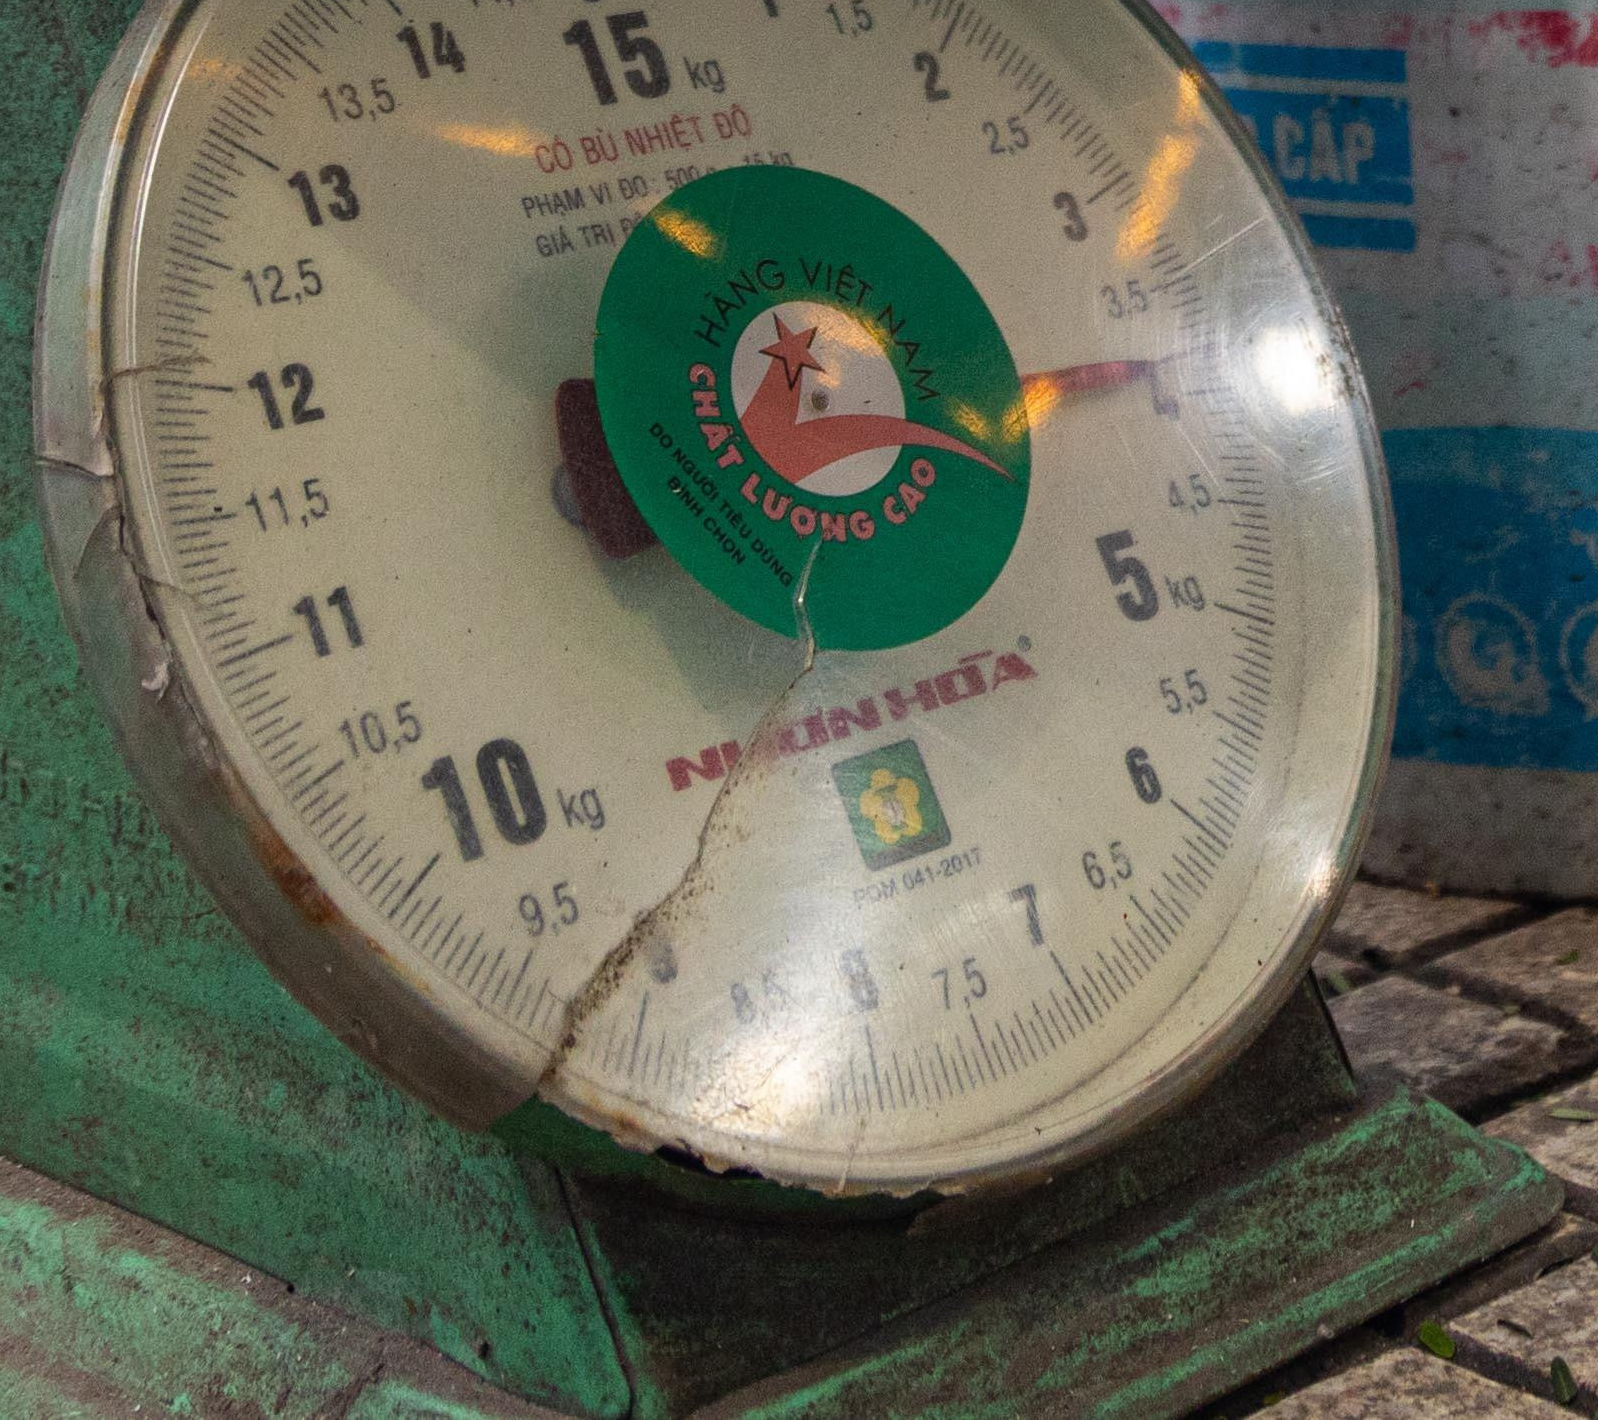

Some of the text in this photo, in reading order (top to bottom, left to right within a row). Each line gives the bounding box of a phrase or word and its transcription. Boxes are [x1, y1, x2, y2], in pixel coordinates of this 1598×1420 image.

[826, 0, 873, 38] 1,5
[396, 21, 466, 80] 14
[562, 10, 726, 105] 15 kg
[913, 51, 951, 102] 2
[318, 77, 396, 123] 13,5
[981, 116, 1031, 156] 2,5
[288, 163, 360, 227] 13
[1052, 191, 1089, 242] 3
[241, 258, 323, 307] 12,5
[1101, 279, 1149, 320] 3,5
[694, 257, 940, 401] HÀNG VIỆT NAM
[247, 362, 326, 430] 12
[649, 422, 673, 449] DO
[245, 477, 329, 532] 11,5
[882, 458, 936, 525] CAO
[1169, 473, 1212, 515] 4,5
[1095, 528, 1205, 621] 5 kg
[292, 585, 365, 658] 11
[1159, 668, 1209, 715] 5,5
[338, 700, 422, 759] 10,5
[421, 737, 606, 862] 10 kg
[1125, 745, 1162, 804] 6
[1082, 841, 1133, 891] 6,5
[517, 881, 580, 938] 9,5
[1008, 883, 1045, 946] 7
[932, 957, 988, 1011] 7,5
